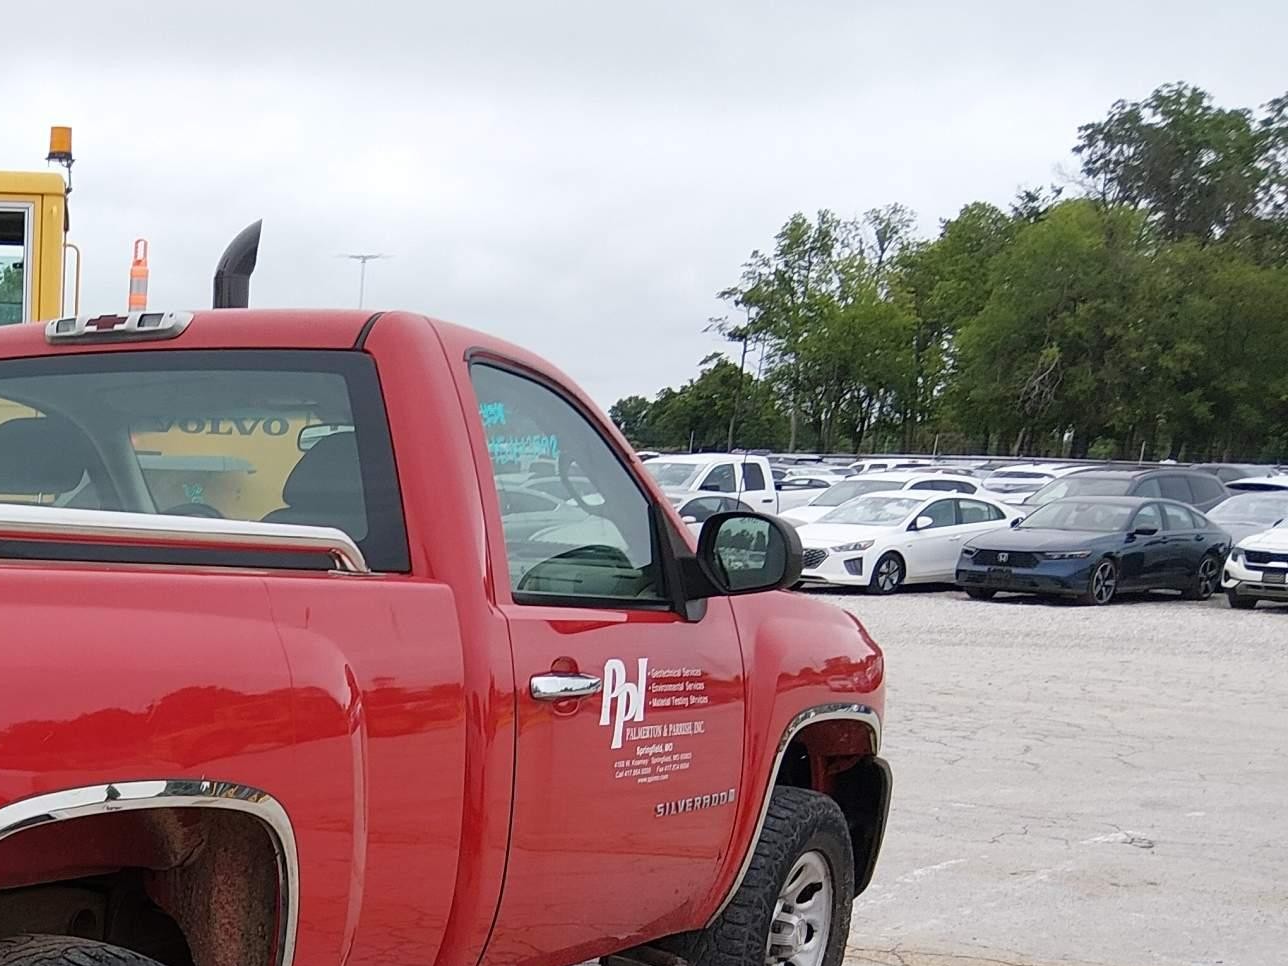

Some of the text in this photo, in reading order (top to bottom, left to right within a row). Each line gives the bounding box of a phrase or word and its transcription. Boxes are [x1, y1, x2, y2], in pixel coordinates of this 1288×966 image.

[153, 415, 290, 436] VOLVO
[625, 725, 662, 742] PALMERTON
[654, 788, 736, 818] SILVERADO
